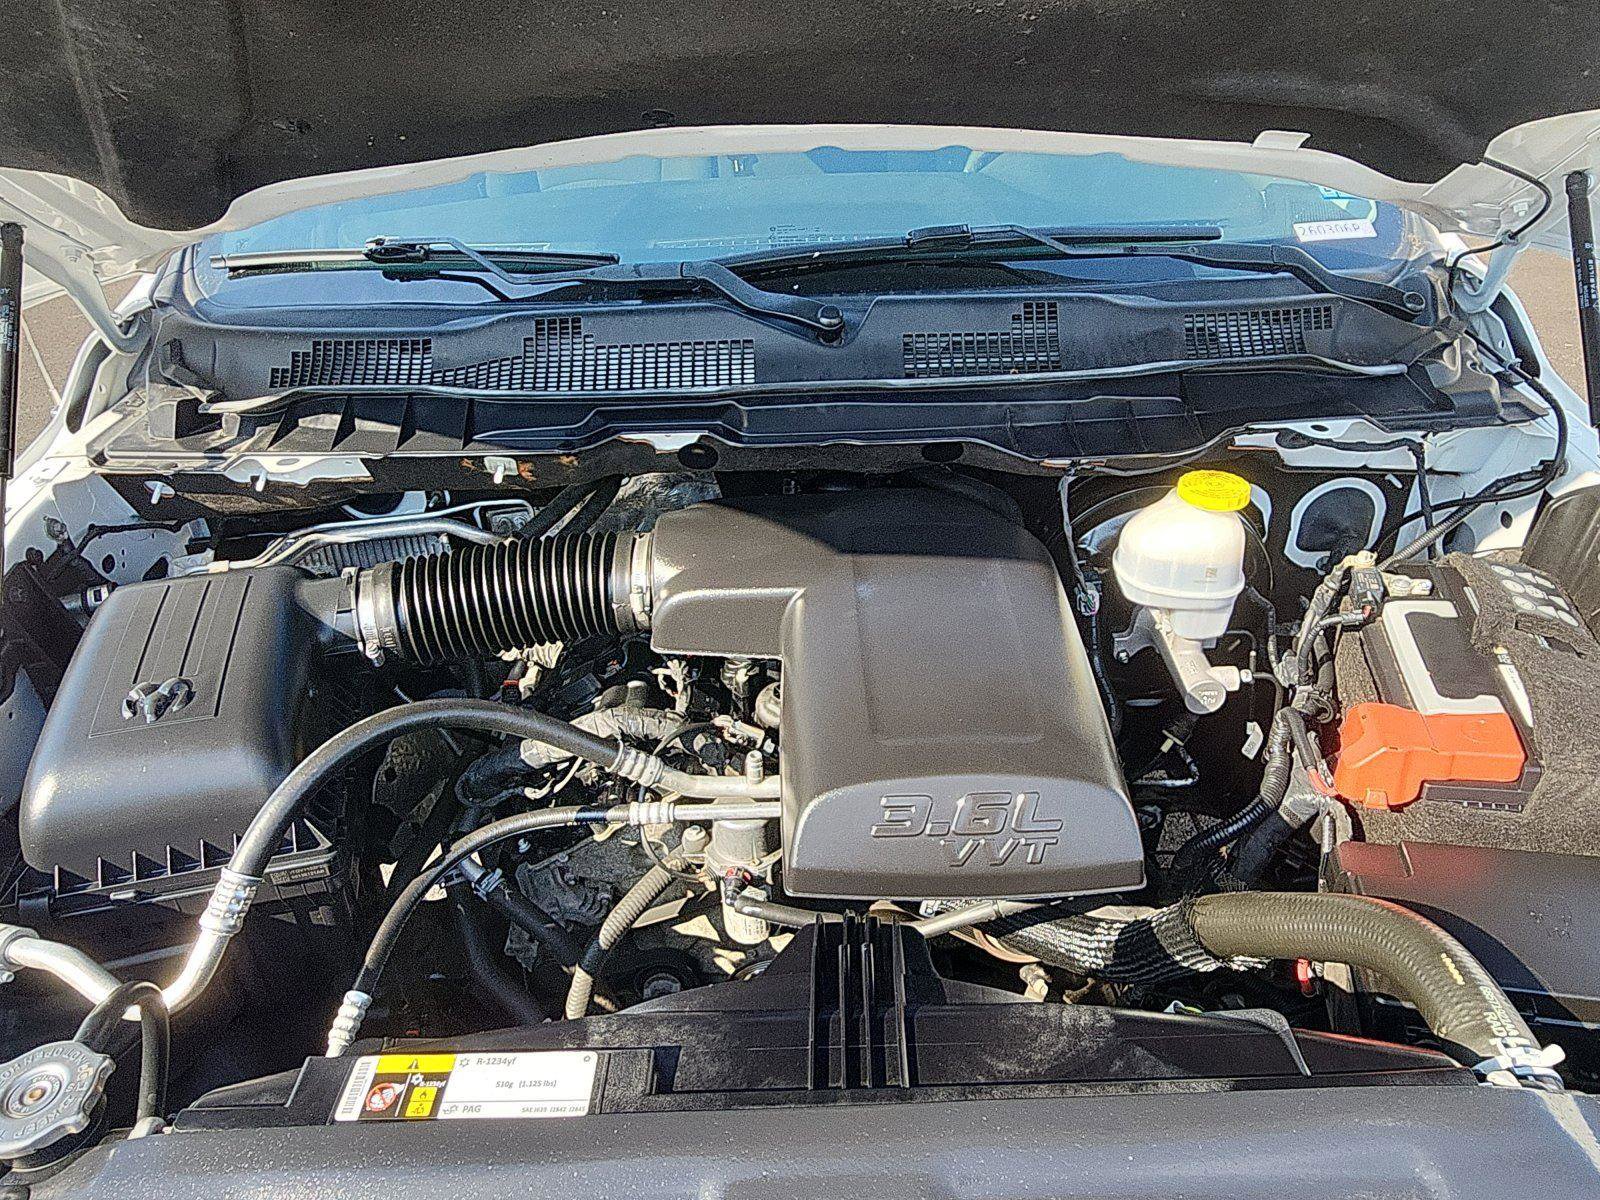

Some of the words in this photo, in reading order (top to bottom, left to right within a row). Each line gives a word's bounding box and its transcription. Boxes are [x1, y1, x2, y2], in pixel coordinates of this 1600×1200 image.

[871, 791, 1064, 837] 3.6L
[939, 836, 1059, 867] VVT
[476, 1057, 517, 1067] R-1234yf
[495, 1080, 514, 1089] 510g
[462, 1104, 482, 1113] PAG
